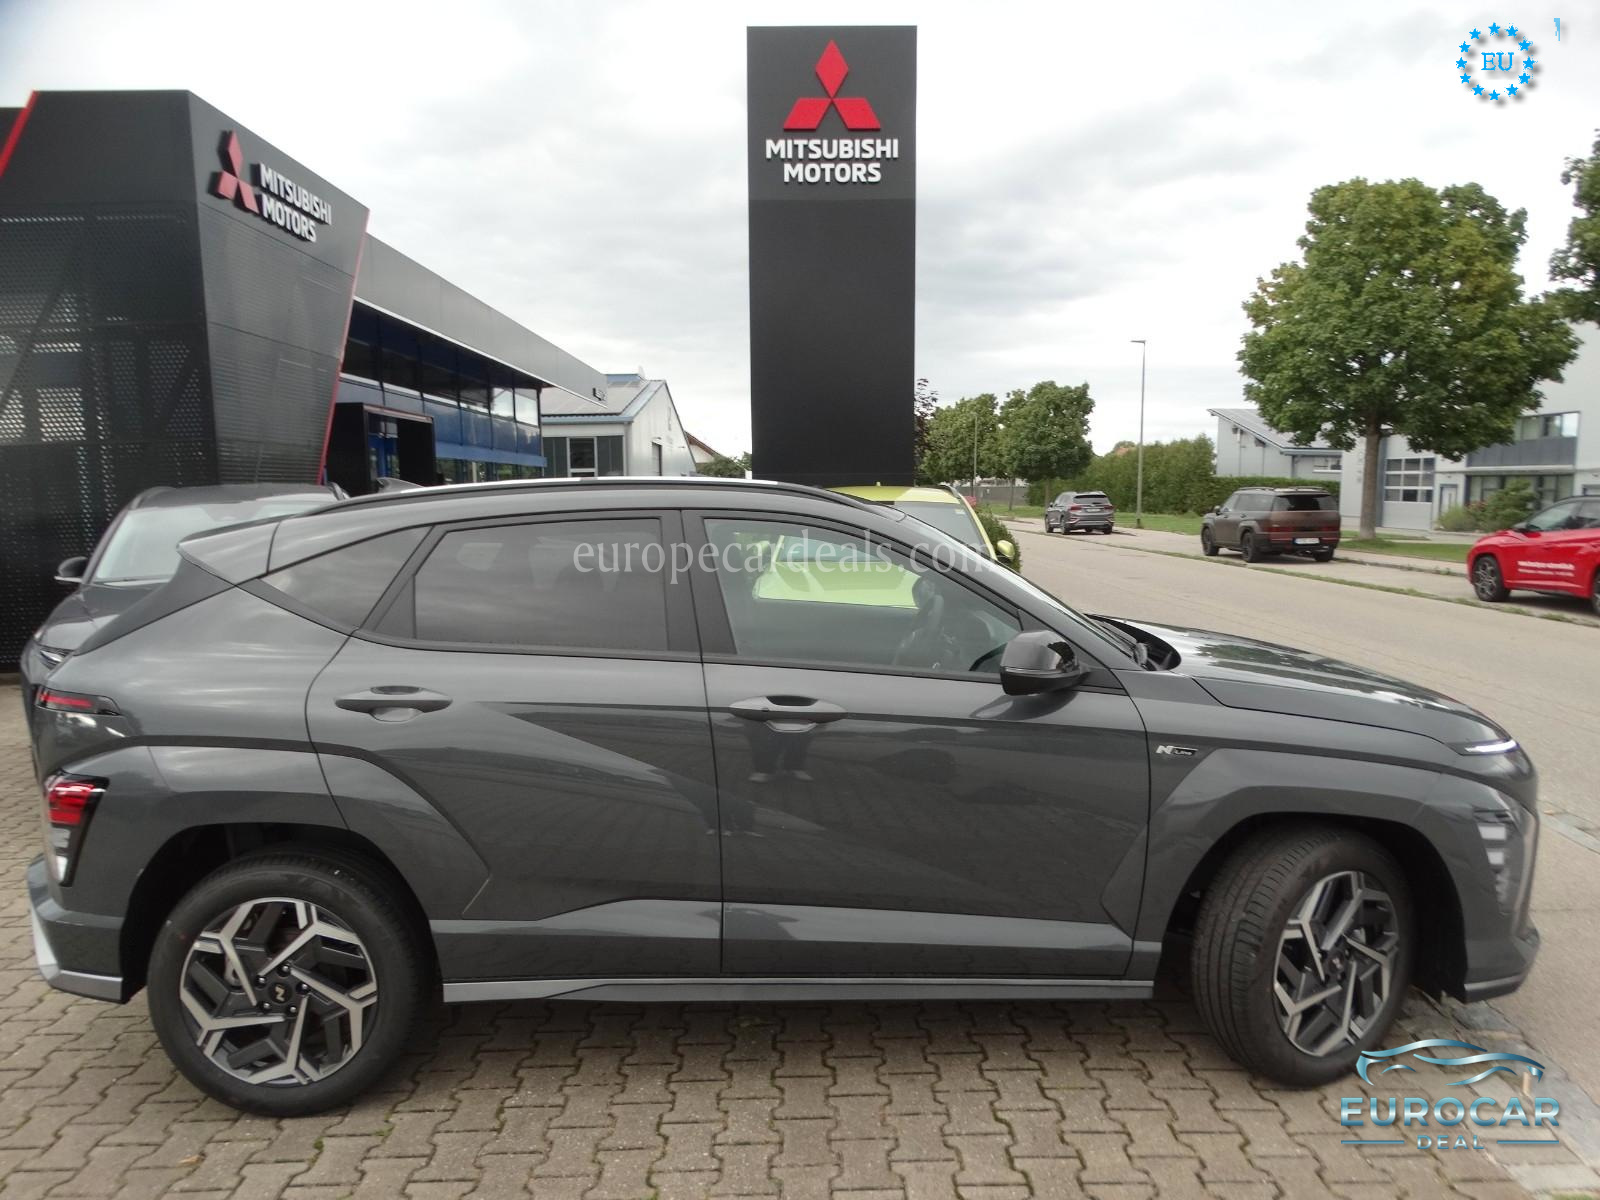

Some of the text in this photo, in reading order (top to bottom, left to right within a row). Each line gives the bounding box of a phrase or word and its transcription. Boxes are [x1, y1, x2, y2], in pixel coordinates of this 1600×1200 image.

[765, 138, 899, 160] MITSUBISHI
[783, 162, 882, 183] MOTORS
[259, 162, 332, 226] MITSUBISHI
[261, 192, 317, 243] MOTORS
